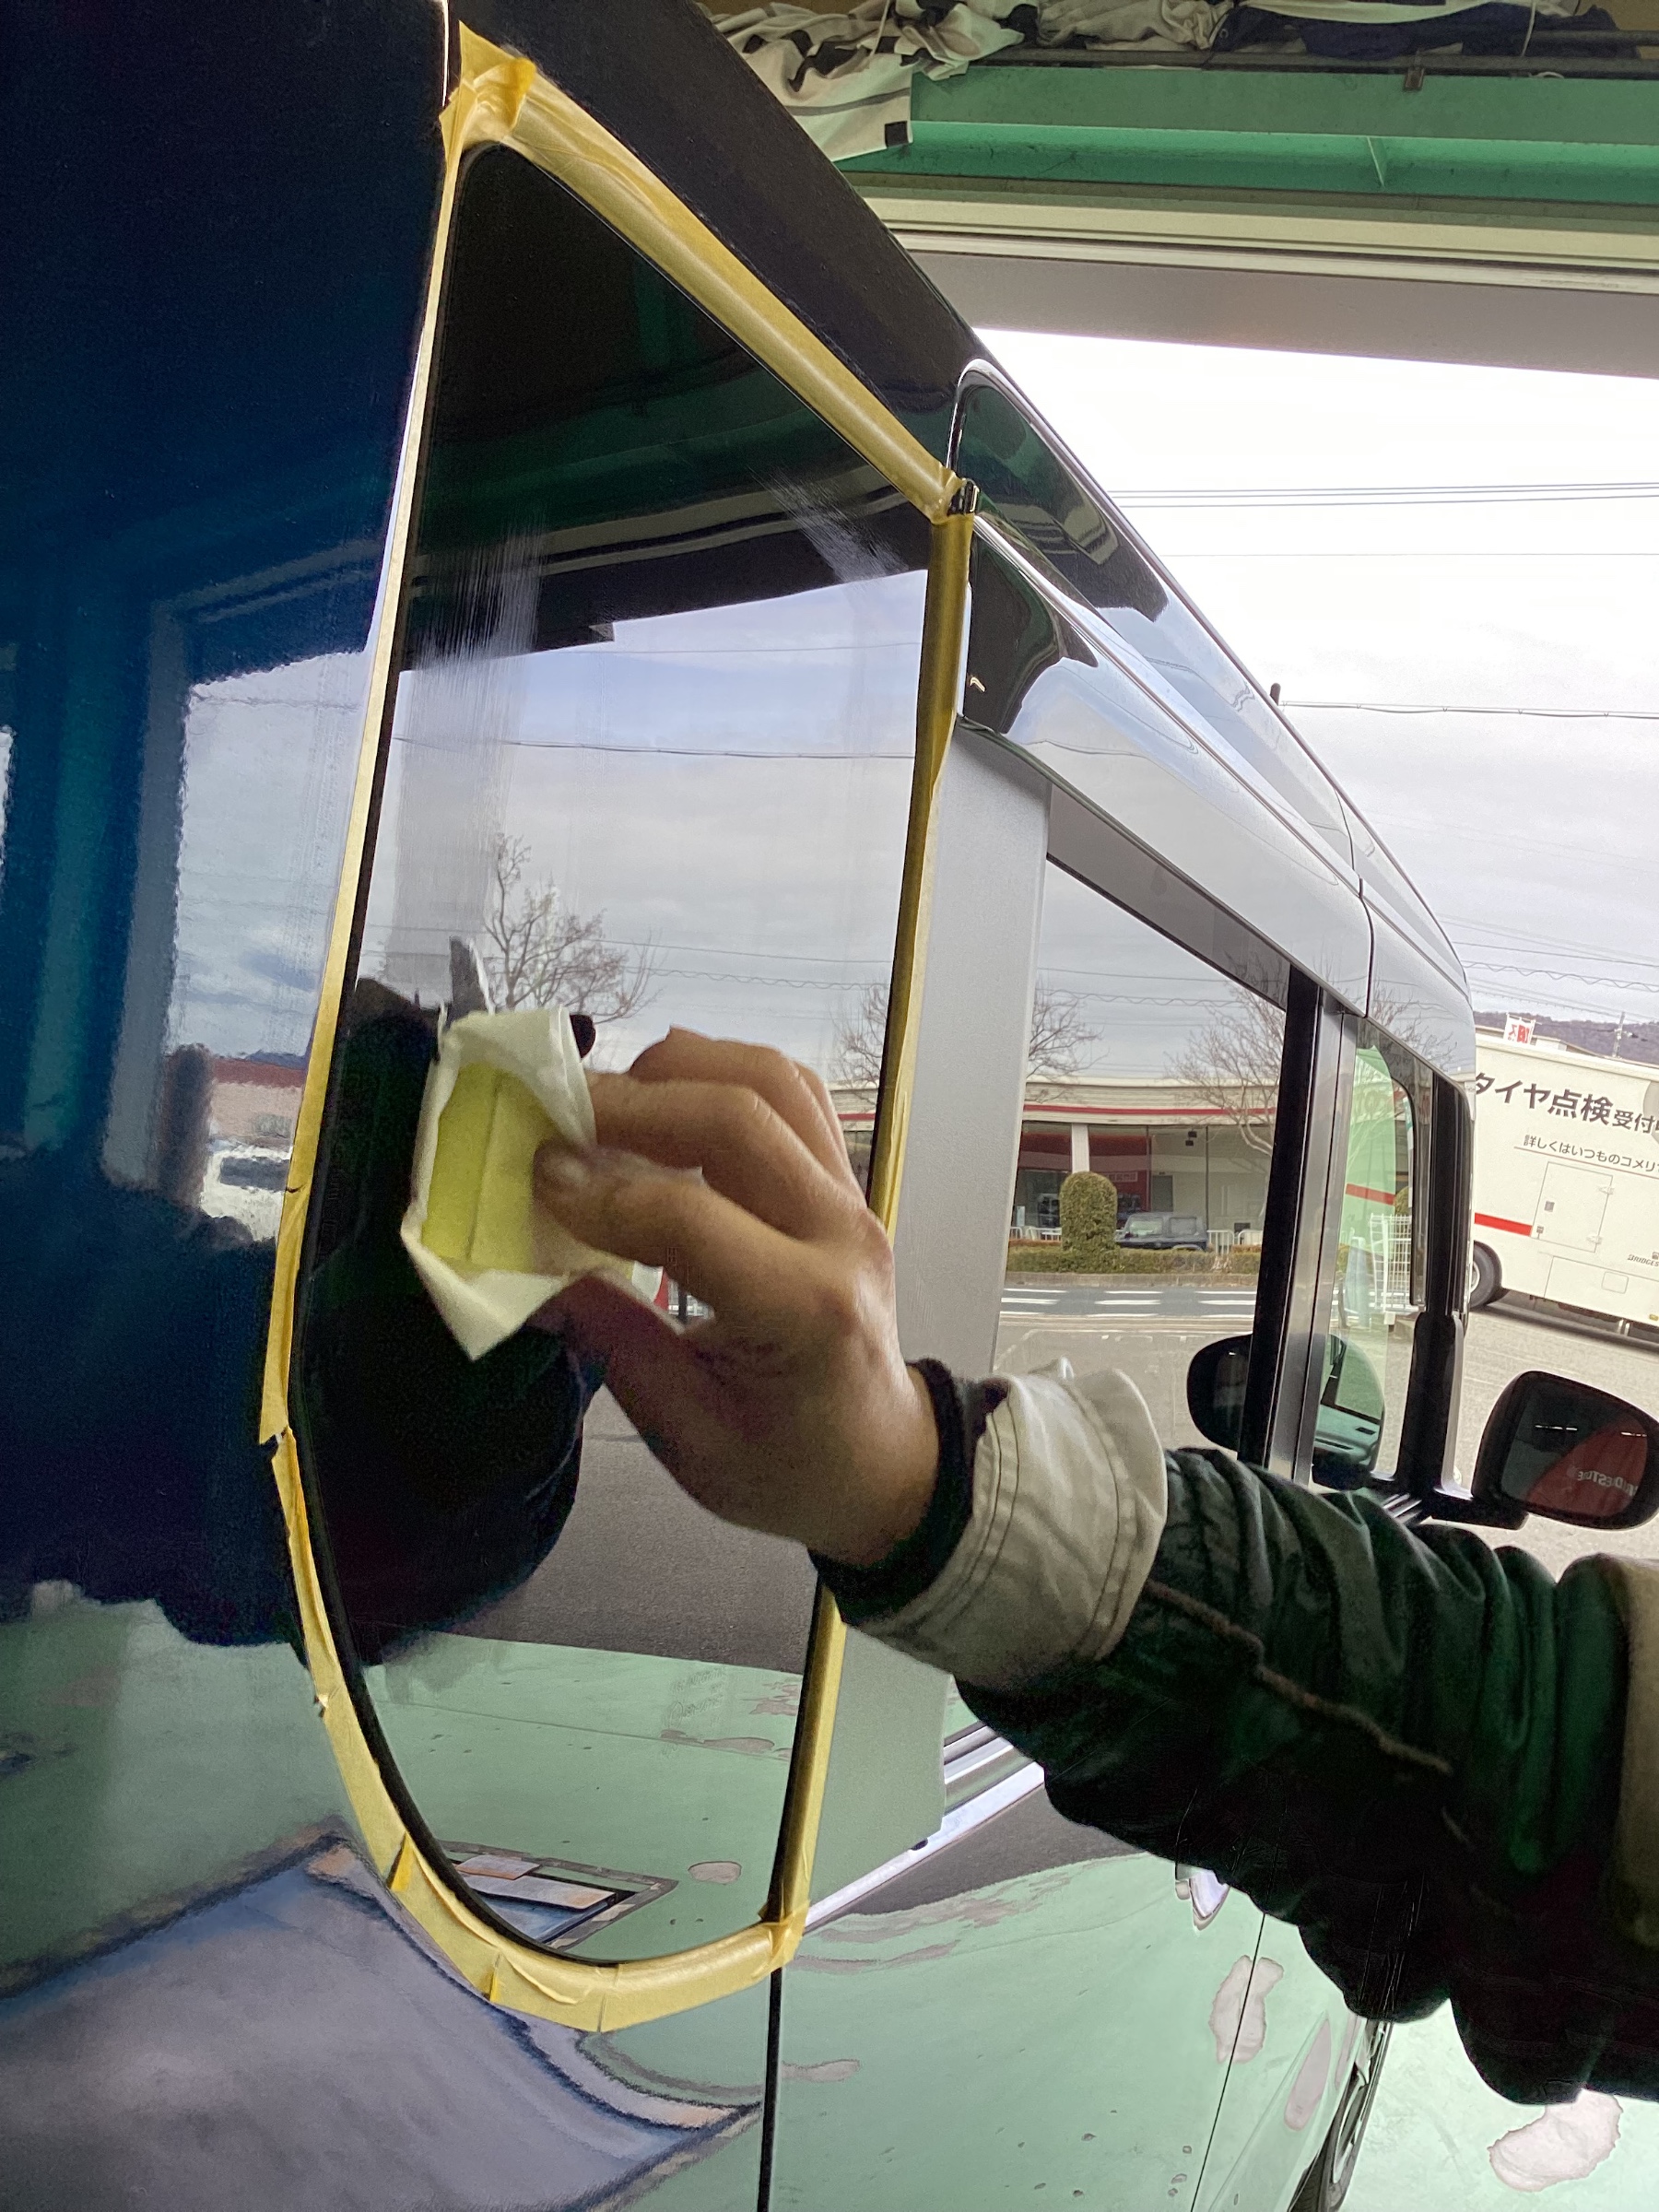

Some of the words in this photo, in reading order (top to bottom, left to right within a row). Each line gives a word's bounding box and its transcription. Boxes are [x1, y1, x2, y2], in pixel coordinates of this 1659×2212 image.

[1476, 1072, 1659, 1134] タイヤ点検受付
[1524, 1134, 1659, 1173] 詳しくはいつものコメリ
